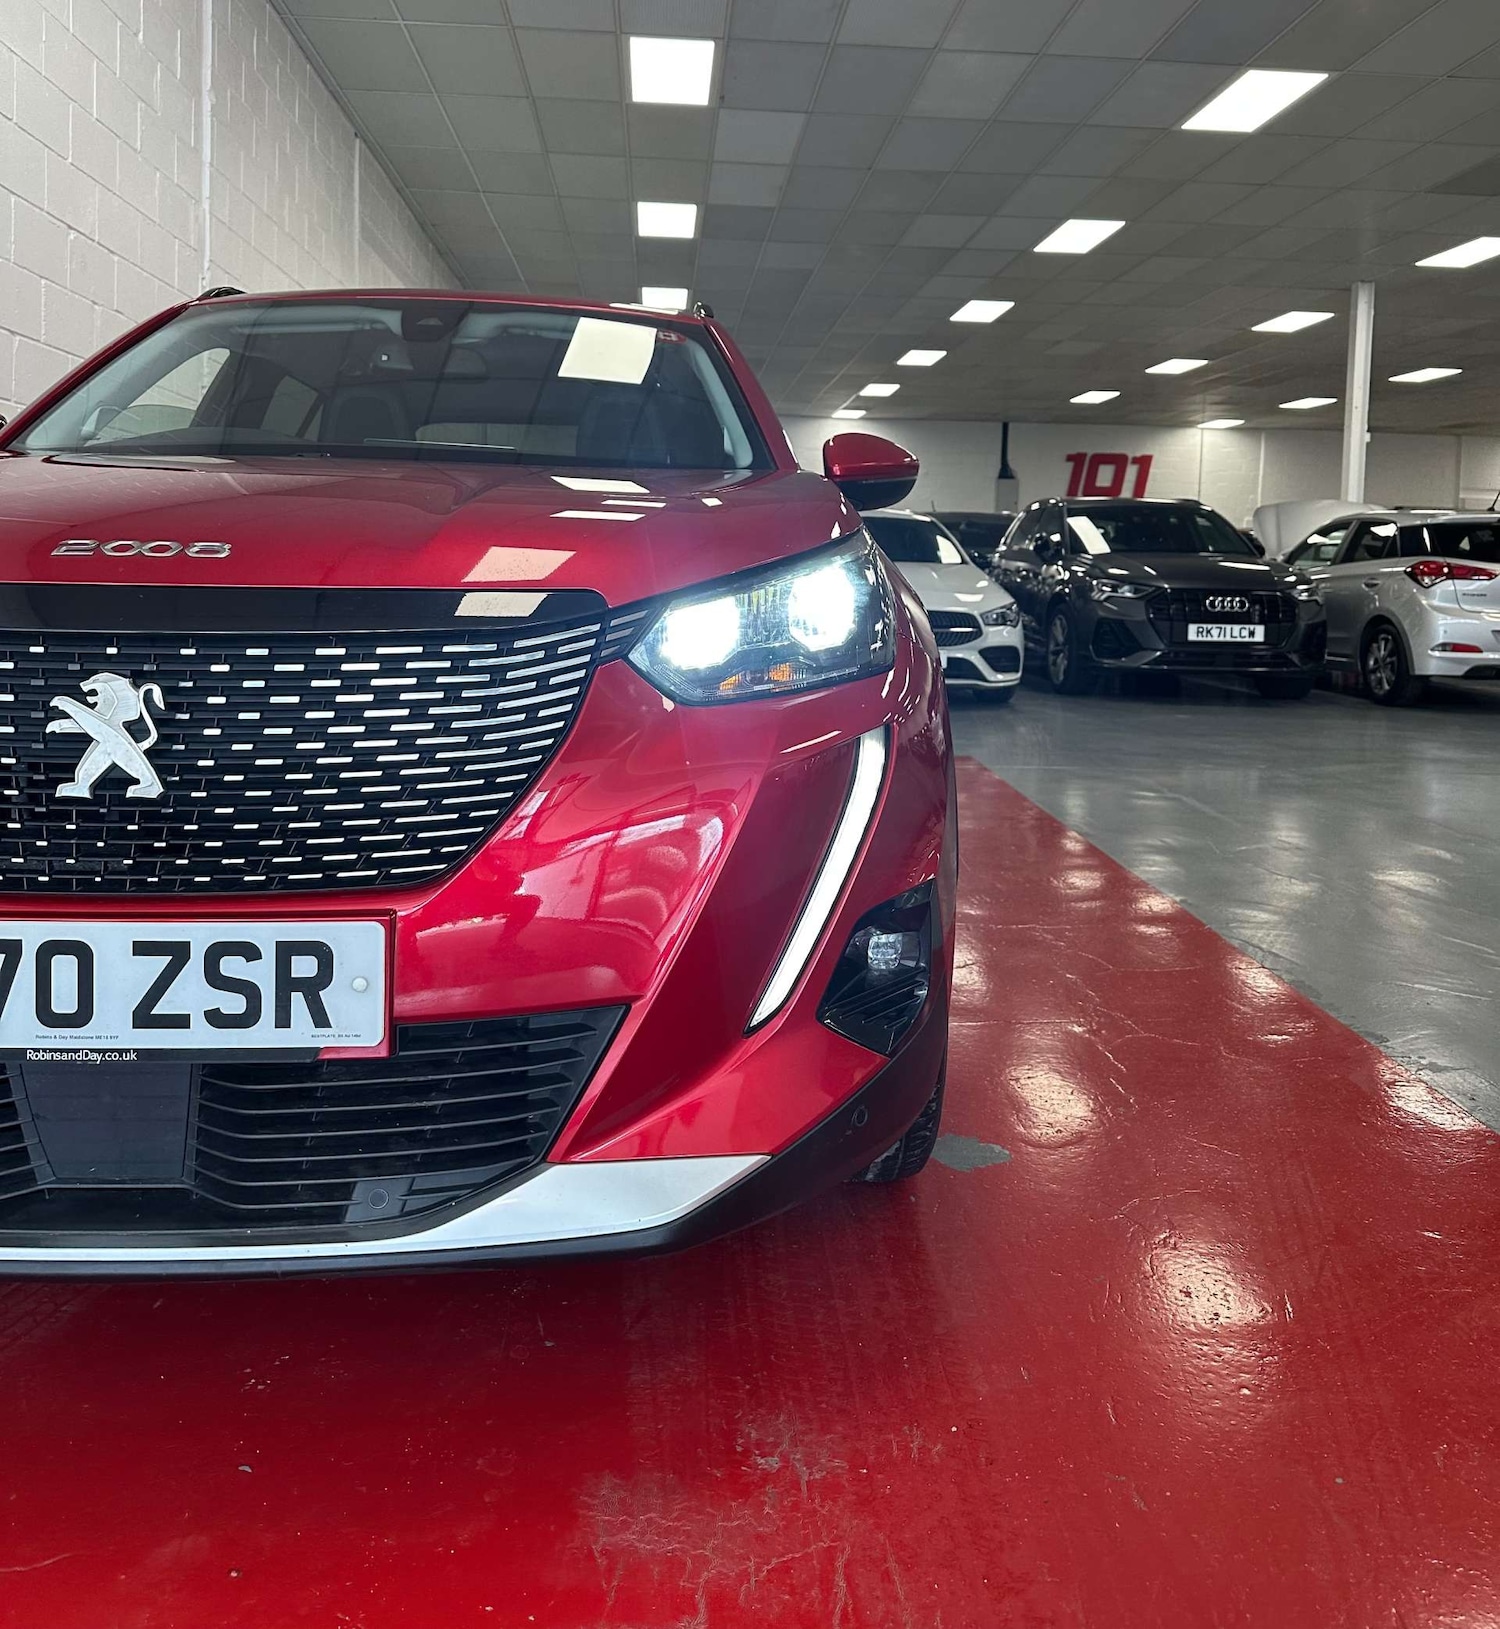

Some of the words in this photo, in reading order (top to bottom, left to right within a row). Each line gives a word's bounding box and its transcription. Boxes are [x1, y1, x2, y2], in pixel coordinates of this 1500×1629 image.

[1065, 452, 1153, 498] 101
[51, 539, 232, 558] 2008
[1196, 626, 1227, 638] RK71
[1230, 627, 1256, 639] LCW
[132, 940, 334, 1030] ZSR
[26, 1049, 138, 1065] RobinsandDay.co.uk
